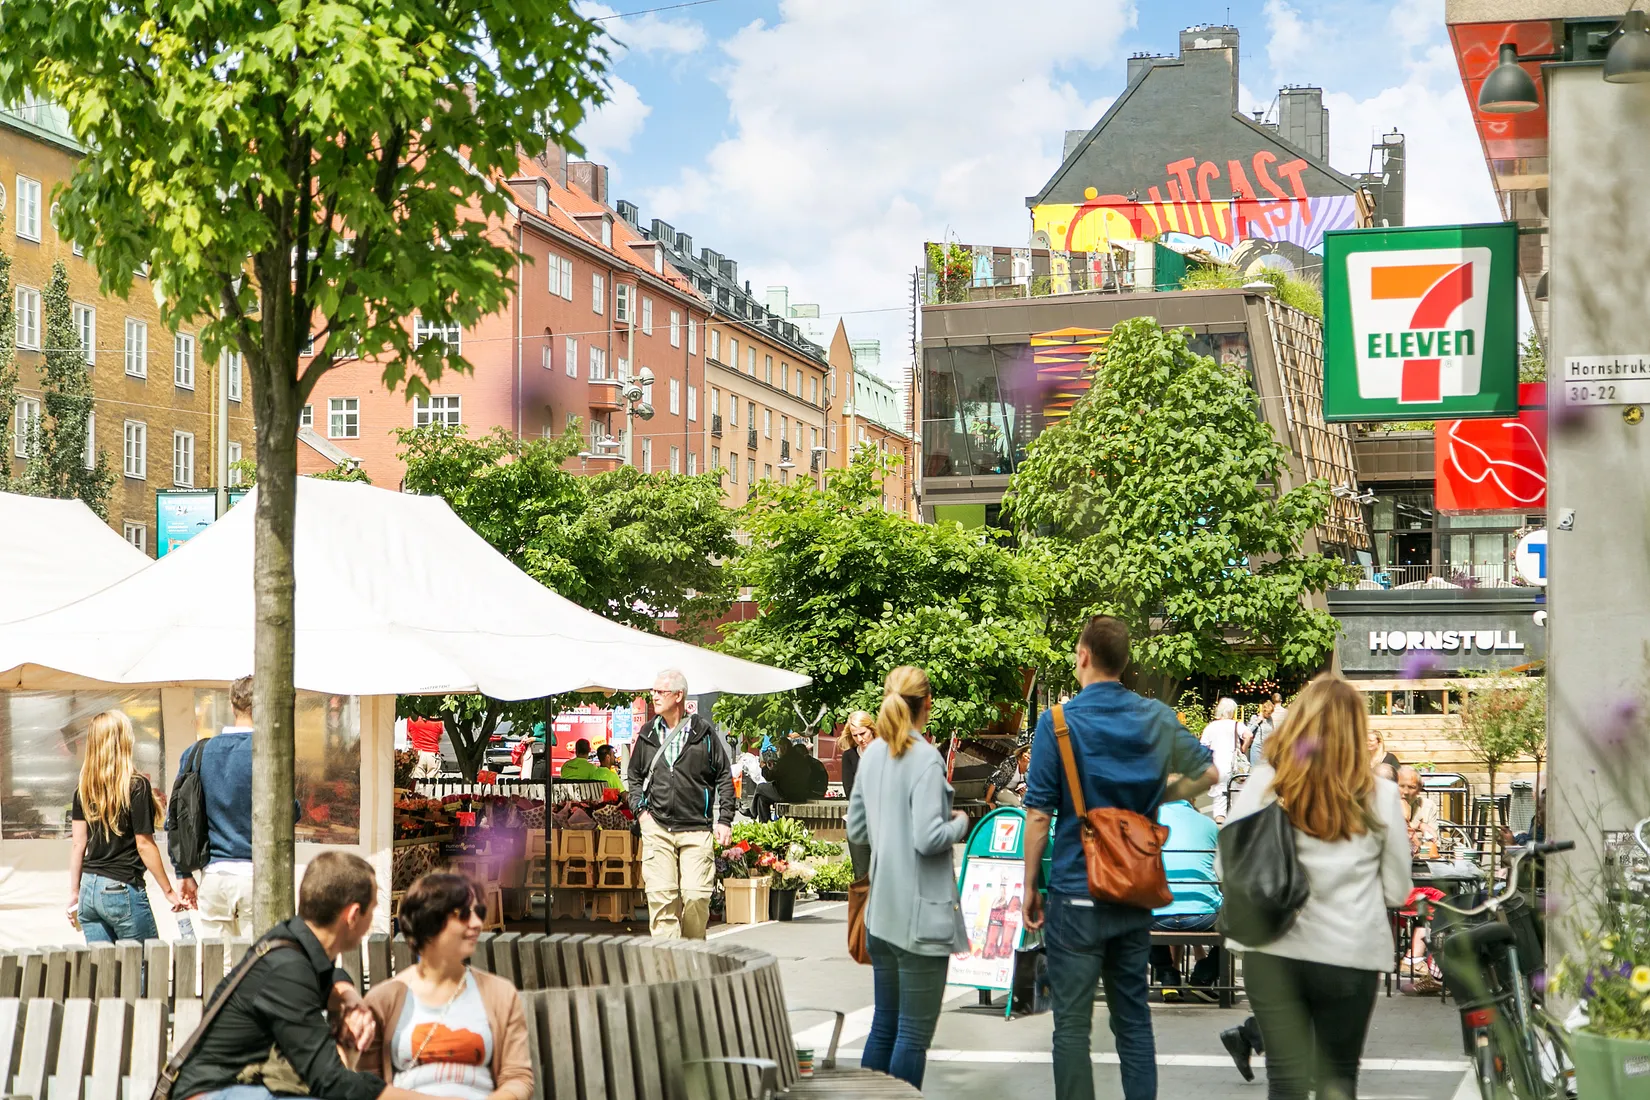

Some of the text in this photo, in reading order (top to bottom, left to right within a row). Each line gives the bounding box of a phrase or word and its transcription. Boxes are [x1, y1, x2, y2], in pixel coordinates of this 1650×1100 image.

[1065, 151, 1312, 251] OUTCAST
[1371, 261, 1473, 402] 7
[1571, 359, 1650, 376] Hornsbruk
[1571, 386, 1616, 401] 30-22
[1369, 630, 1525, 650] HORNSTULL
